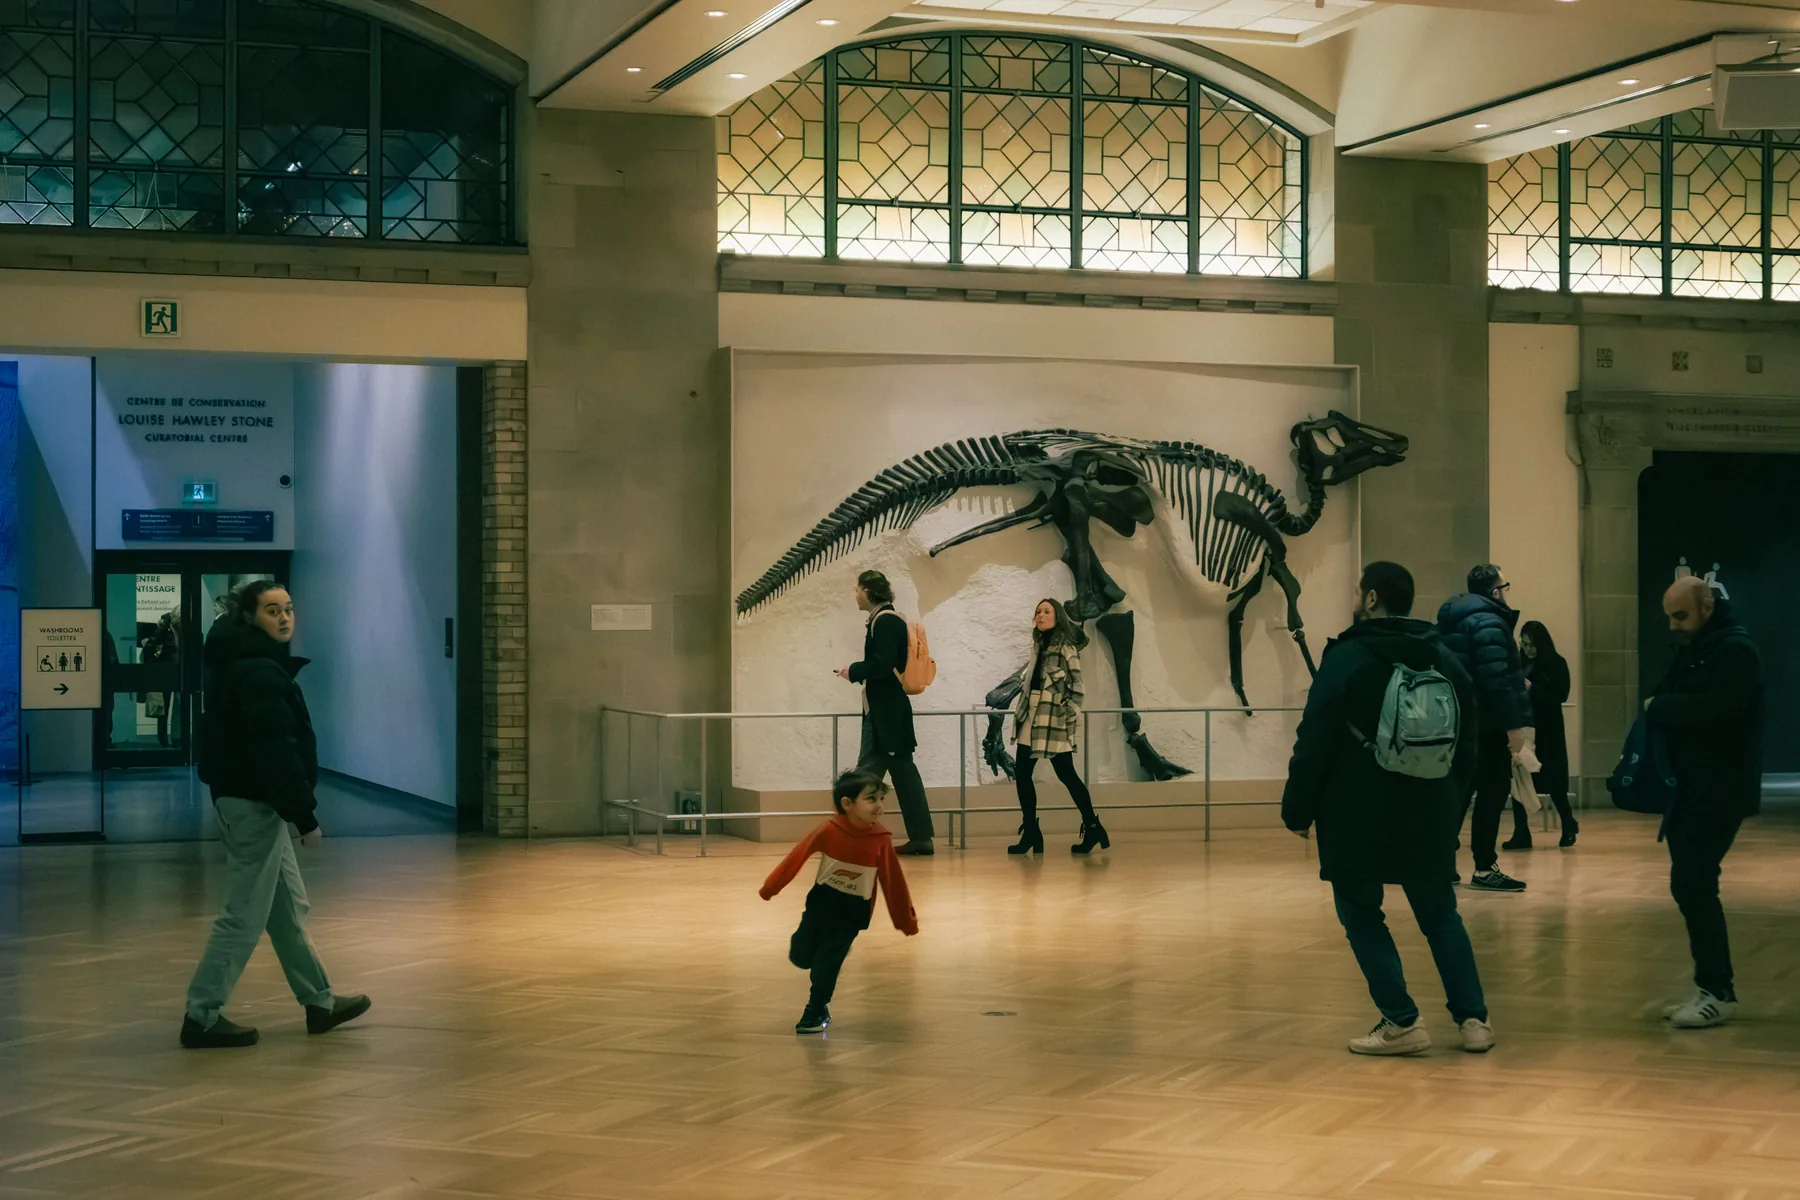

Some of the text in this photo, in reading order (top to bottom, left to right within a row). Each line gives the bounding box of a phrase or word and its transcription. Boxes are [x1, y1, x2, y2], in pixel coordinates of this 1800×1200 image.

[127, 397, 166, 406] CENTRE
[189, 398, 266, 408] CONSERVATION
[118, 414, 273, 428] LOUISE HAWLEY STONE
[144, 433, 248, 443] CURATORIAL CENTRE
